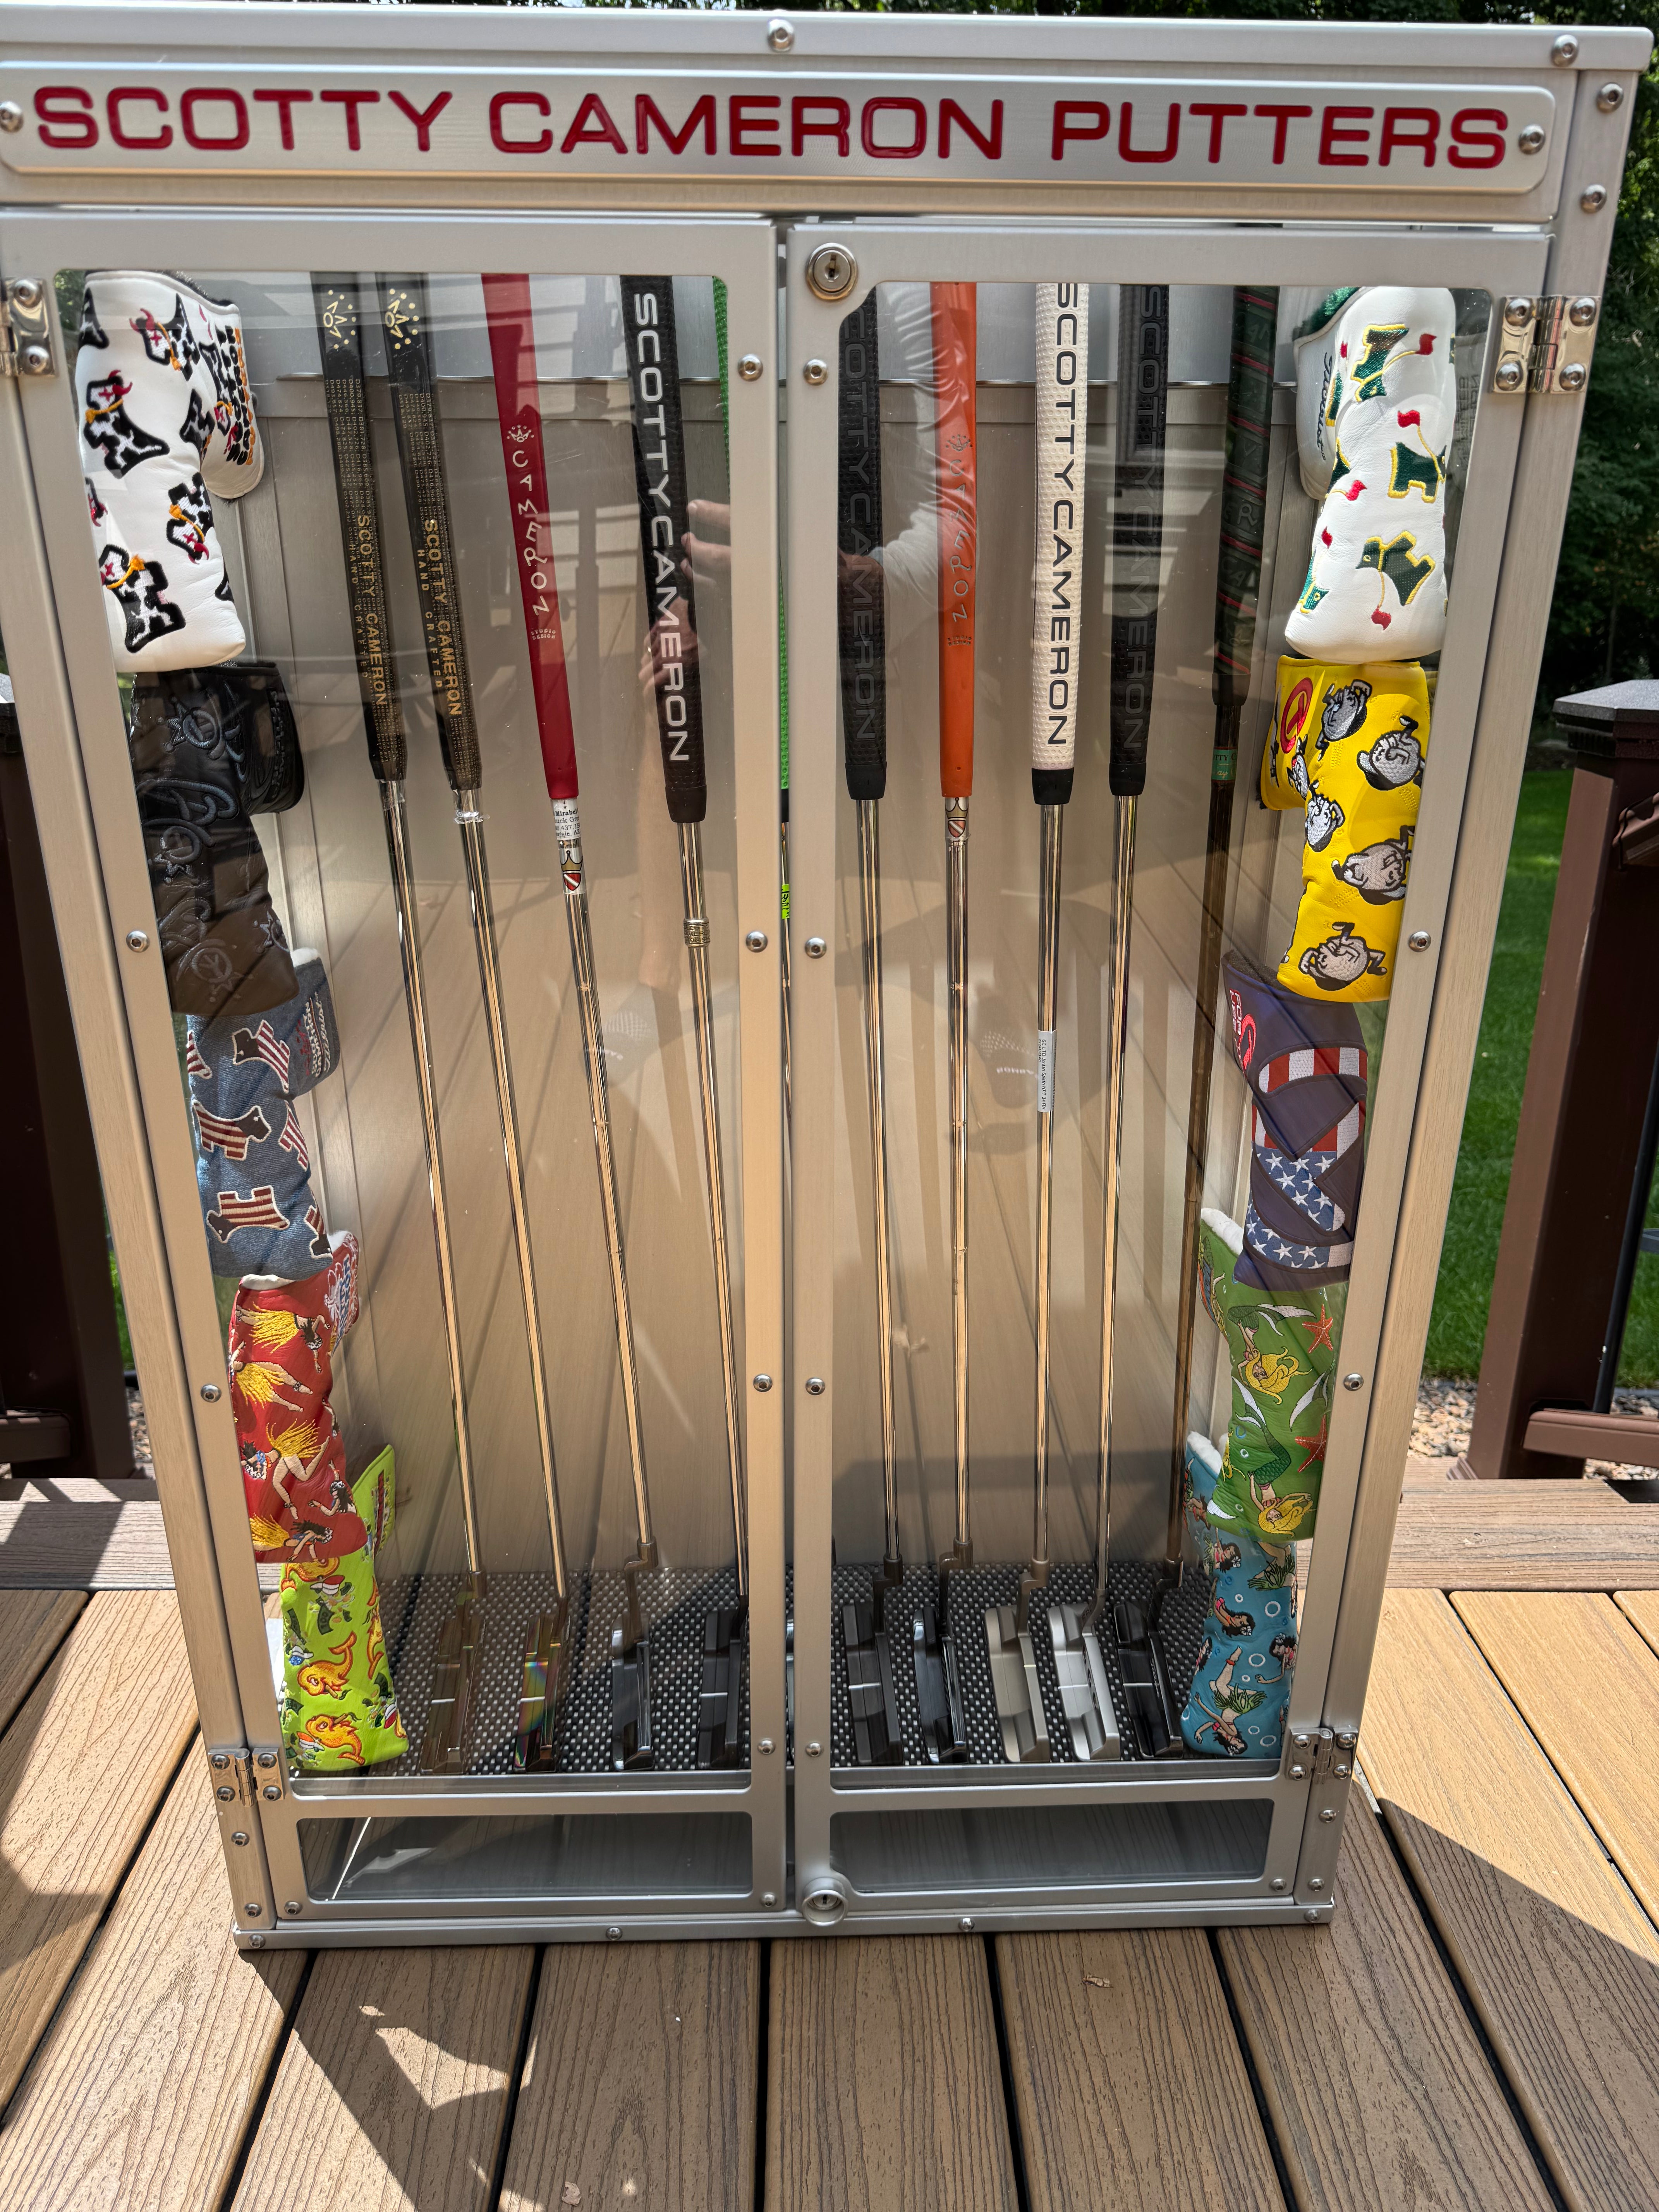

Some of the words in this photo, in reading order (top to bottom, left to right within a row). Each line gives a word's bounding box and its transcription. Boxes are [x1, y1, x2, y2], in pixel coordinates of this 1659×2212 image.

[35, 88, 452, 151] SCOTTY
[490, 93, 1003, 159] CAMERON
[1052, 101, 1507, 169] PUTTERS
[634, 293, 671, 507] SCOTTY
[1055, 283, 1078, 491] SCOTTY
[1134, 287, 1161, 494] SCOTTY
[349, 544, 359, 584] HAND
[354, 605, 368, 678] CRAFTED
[357, 515, 376, 597] SCOTTY
[416, 549, 429, 591] HAND
[425, 611, 443, 688] CRAFTED
[425, 520, 447, 604] SCOTTY
[438, 620, 462, 715] CAMERON
[512, 450, 550, 616] CAMERON
[849, 493, 877, 741] CAMERON
[949, 459, 972, 623] CAMERON
[1048, 500, 1073, 745] CAMERON
[1124, 505, 1159, 749] CAMERON
[365, 613, 388, 706] CAMERON
[651, 515, 690, 762] CAMERON
